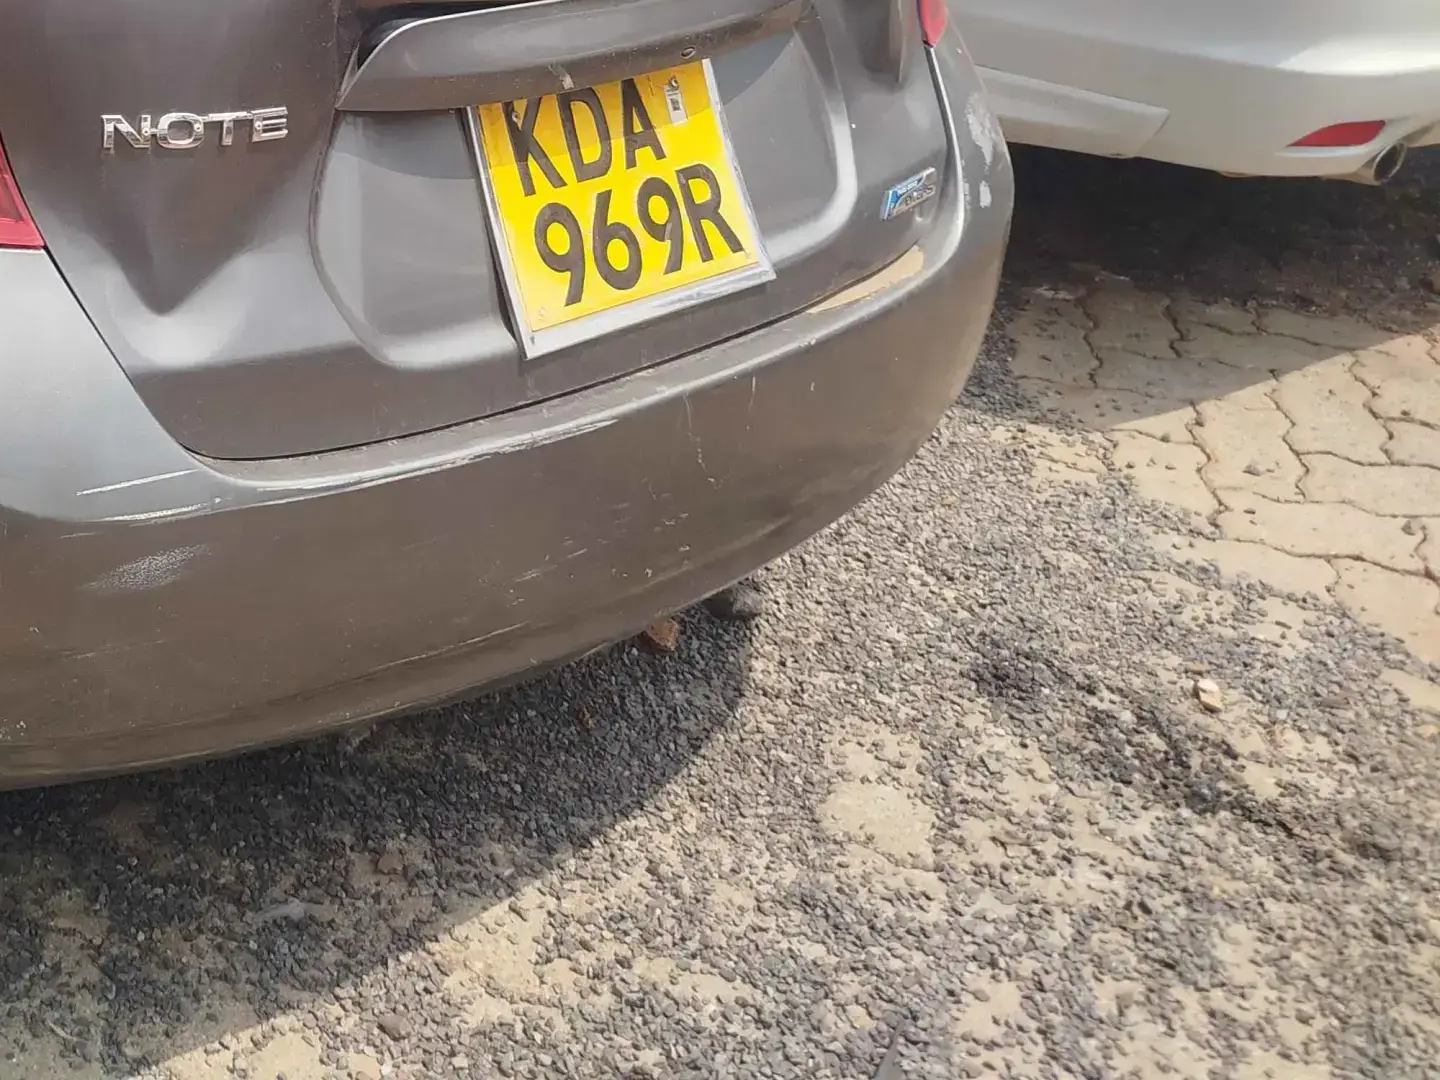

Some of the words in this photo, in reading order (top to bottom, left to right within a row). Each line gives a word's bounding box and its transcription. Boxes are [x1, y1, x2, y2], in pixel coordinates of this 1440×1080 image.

[100, 106, 288, 150] NOTE
[501, 77, 667, 197] KDA
[534, 163, 745, 307] 969R
